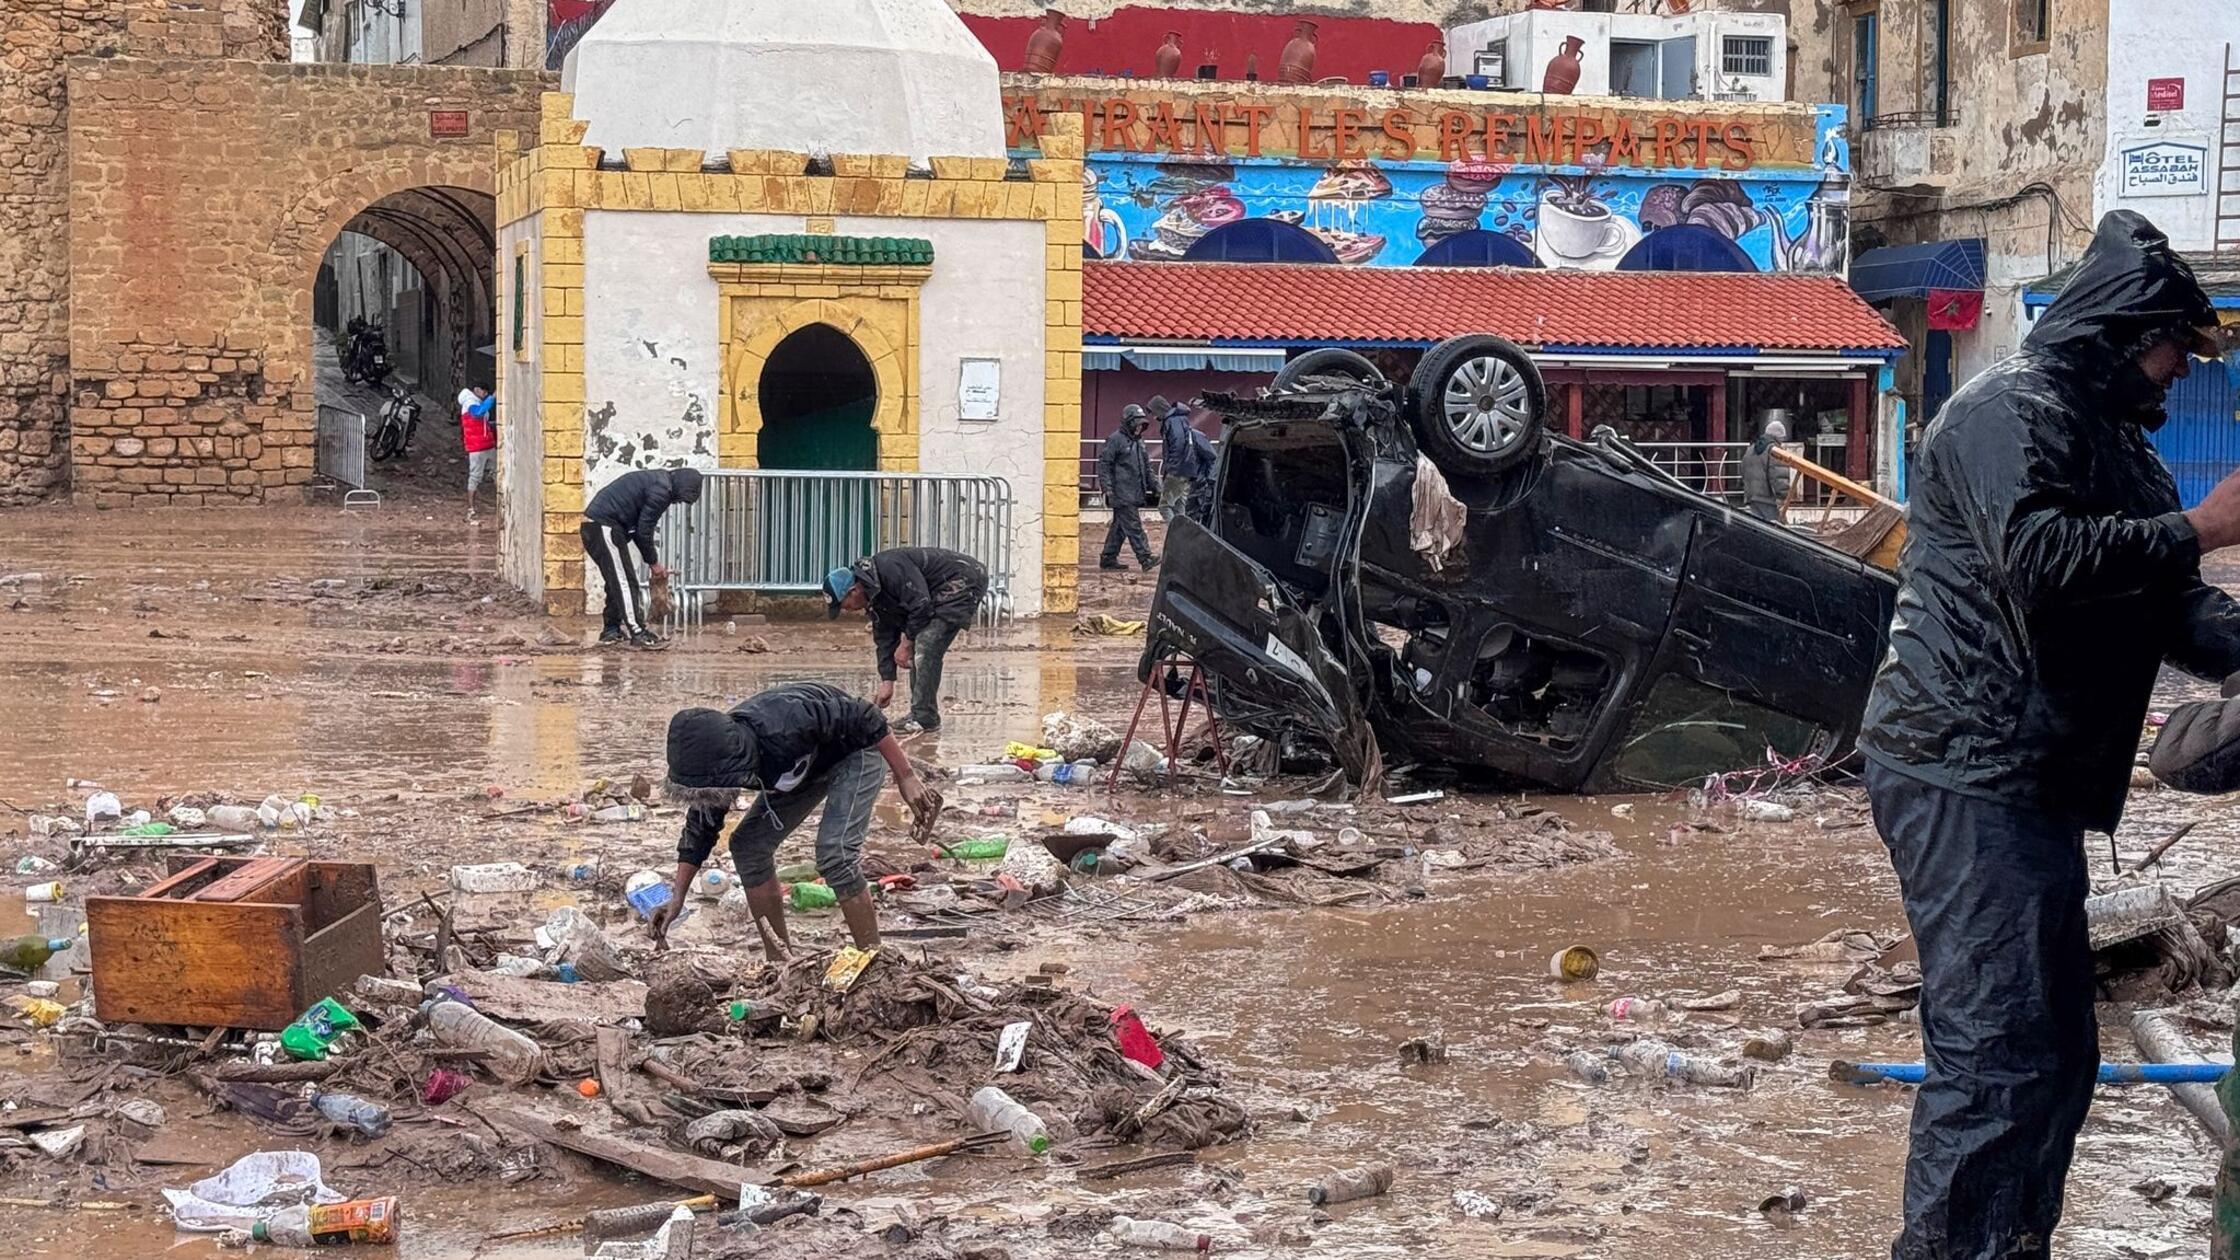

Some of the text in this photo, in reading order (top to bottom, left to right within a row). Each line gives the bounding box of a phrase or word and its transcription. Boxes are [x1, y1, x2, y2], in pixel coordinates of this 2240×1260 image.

[1296, 107, 1417, 161] LES
[1439, 111, 1756, 171] REMPARTS
[2129, 164, 2198, 173] ASSABAH
[2128, 173, 2198, 187] فندق الصباح
